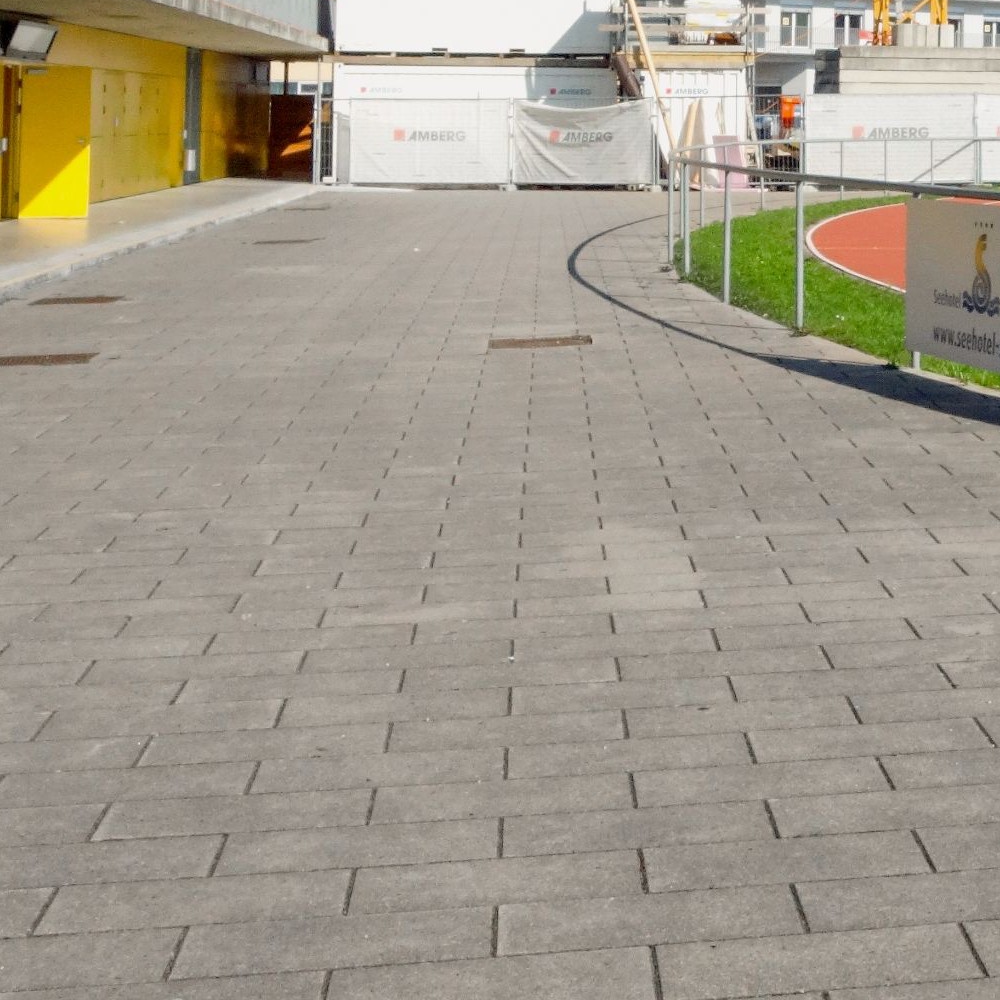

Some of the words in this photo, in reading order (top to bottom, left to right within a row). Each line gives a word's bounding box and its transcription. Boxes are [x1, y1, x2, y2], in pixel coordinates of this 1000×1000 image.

[559, 87, 592, 96] AMBERG
[408, 130, 466, 142] AMBERG
[562, 131, 614, 143] AMBERG
[868, 126, 930, 140] AMBERG
[933, 288, 962, 309] Seehotel
